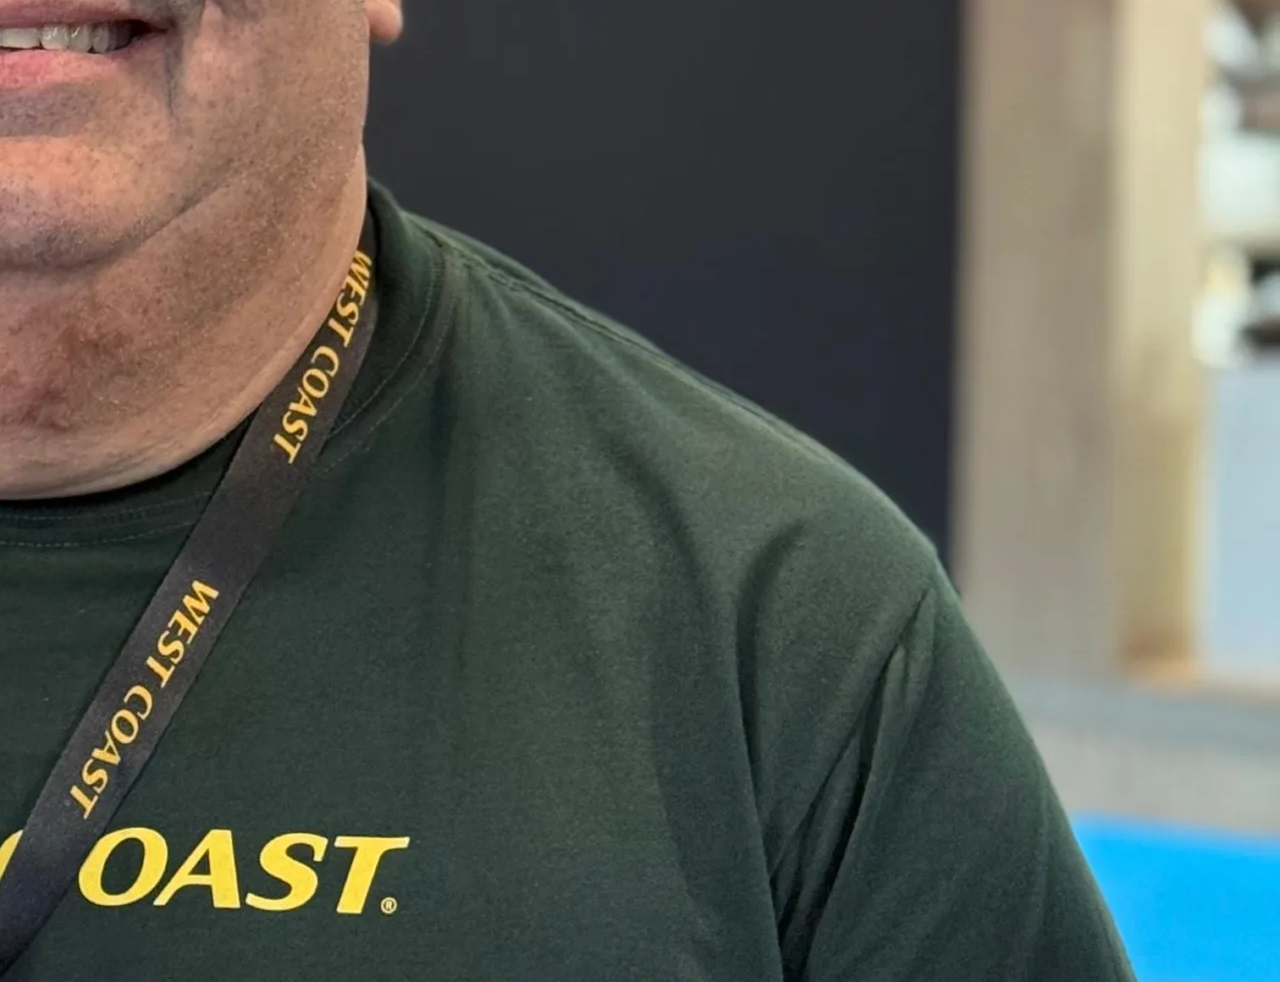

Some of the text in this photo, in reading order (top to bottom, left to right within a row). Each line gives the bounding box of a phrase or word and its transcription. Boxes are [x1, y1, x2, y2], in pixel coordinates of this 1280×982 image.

[273, 250, 372, 464] WEST COAST
[70, 580, 219, 819] WEST COAST
